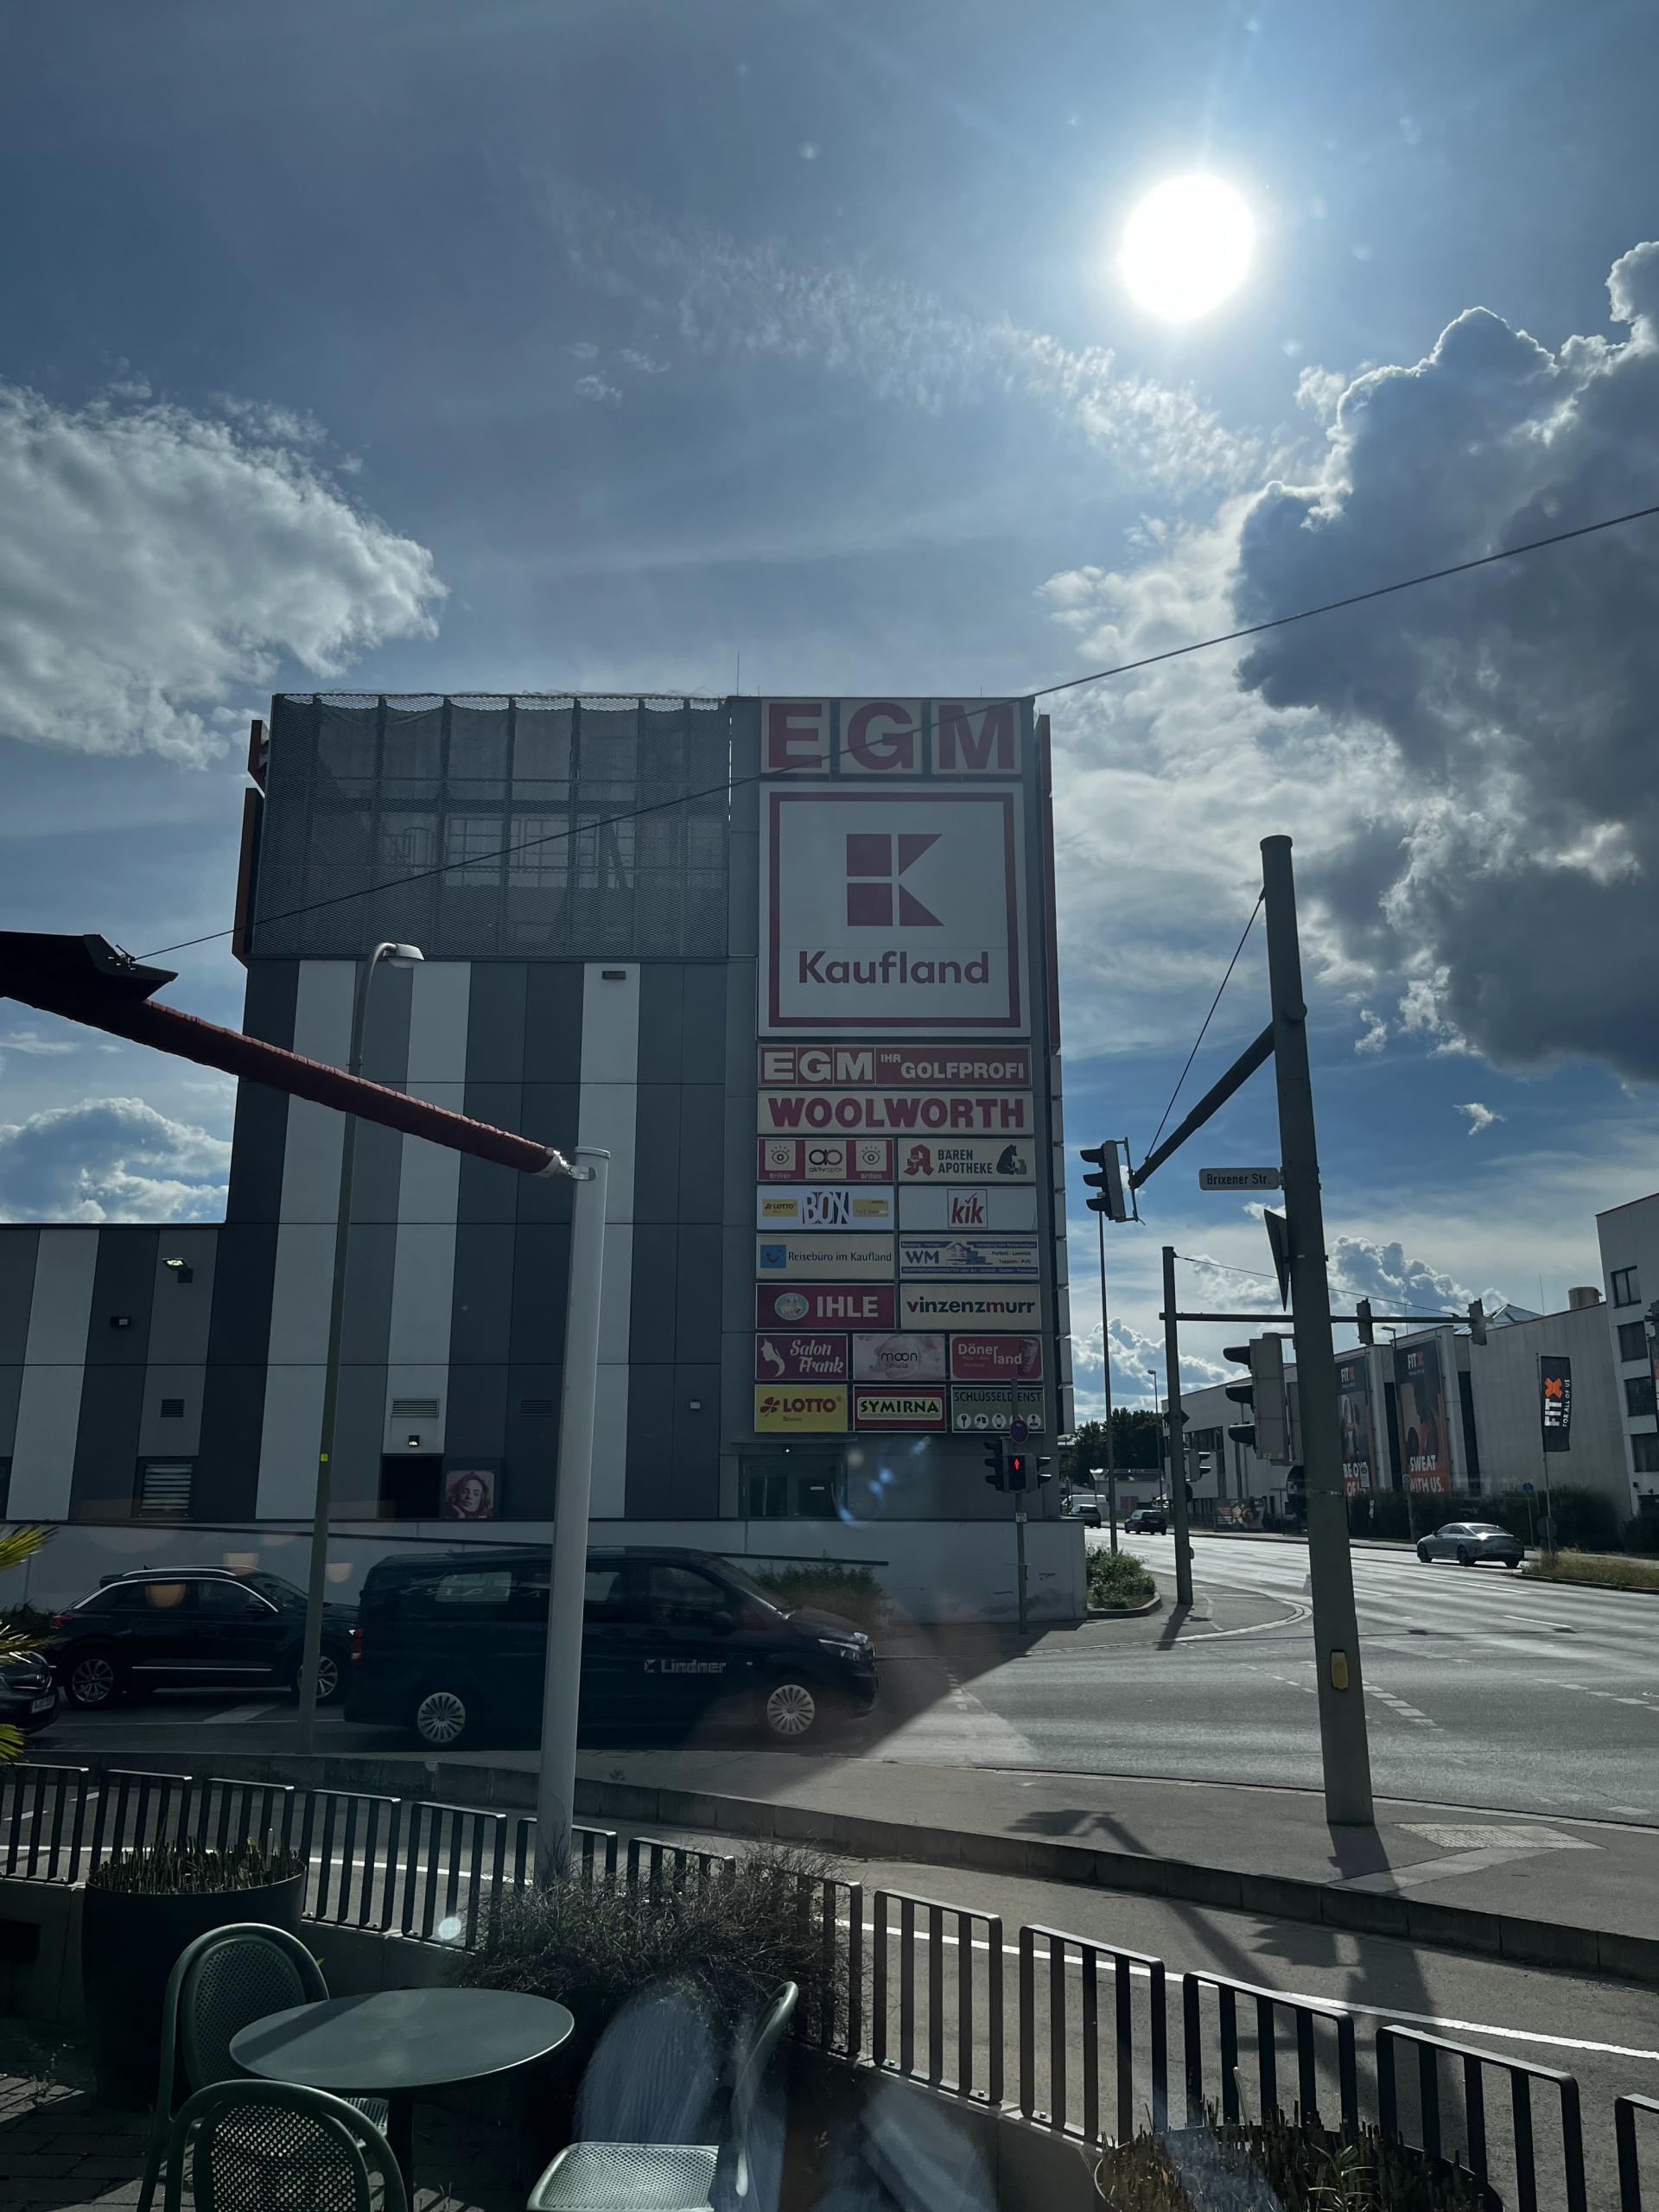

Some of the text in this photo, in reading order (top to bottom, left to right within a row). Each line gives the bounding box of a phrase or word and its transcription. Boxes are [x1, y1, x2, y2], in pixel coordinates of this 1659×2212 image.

[768, 702, 1014, 770] EGM
[798, 950, 989, 984] Kaufland
[880, 1053, 901, 1063] IHR
[764, 1051, 873, 1081] EGM
[900, 1062, 1024, 1078] GOLFPROFI
[767, 1097, 1025, 1128] WOOLWORTH
[938, 1149, 973, 1160] BÄREN
[938, 1162, 993, 1174] APOTHEKE
[1206, 1173, 1270, 1185] Brixener Str.
[802, 1192, 849, 1224] BOX
[788, 1251, 892, 1262] Reisebüro im Kaufland
[906, 1250, 939, 1264] WM
[817, 1296, 879, 1318] IHLE
[906, 1296, 1035, 1313] vinzenzmurr
[790, 1339, 832, 1356] Salon
[957, 1343, 998, 1356] Döner
[880, 1352, 918, 1361] moon
[993, 1352, 1022, 1364] land
[798, 1356, 844, 1373] Frank
[1564, 1379, 1570, 1388] US
[954, 1390, 1041, 1402] SCHLÜSSELDENST
[1565, 1389, 1570, 1399] OF
[783, 1398, 836, 1413] LOTTO
[860, 1400, 939, 1414] SYMIRNA
[1409, 1454, 1436, 1472] SWEAT
[1343, 1463, 1352, 1478] BE
[1409, 1476, 1445, 1493] WITH US.
[660, 1659, 727, 1673] Lindner
